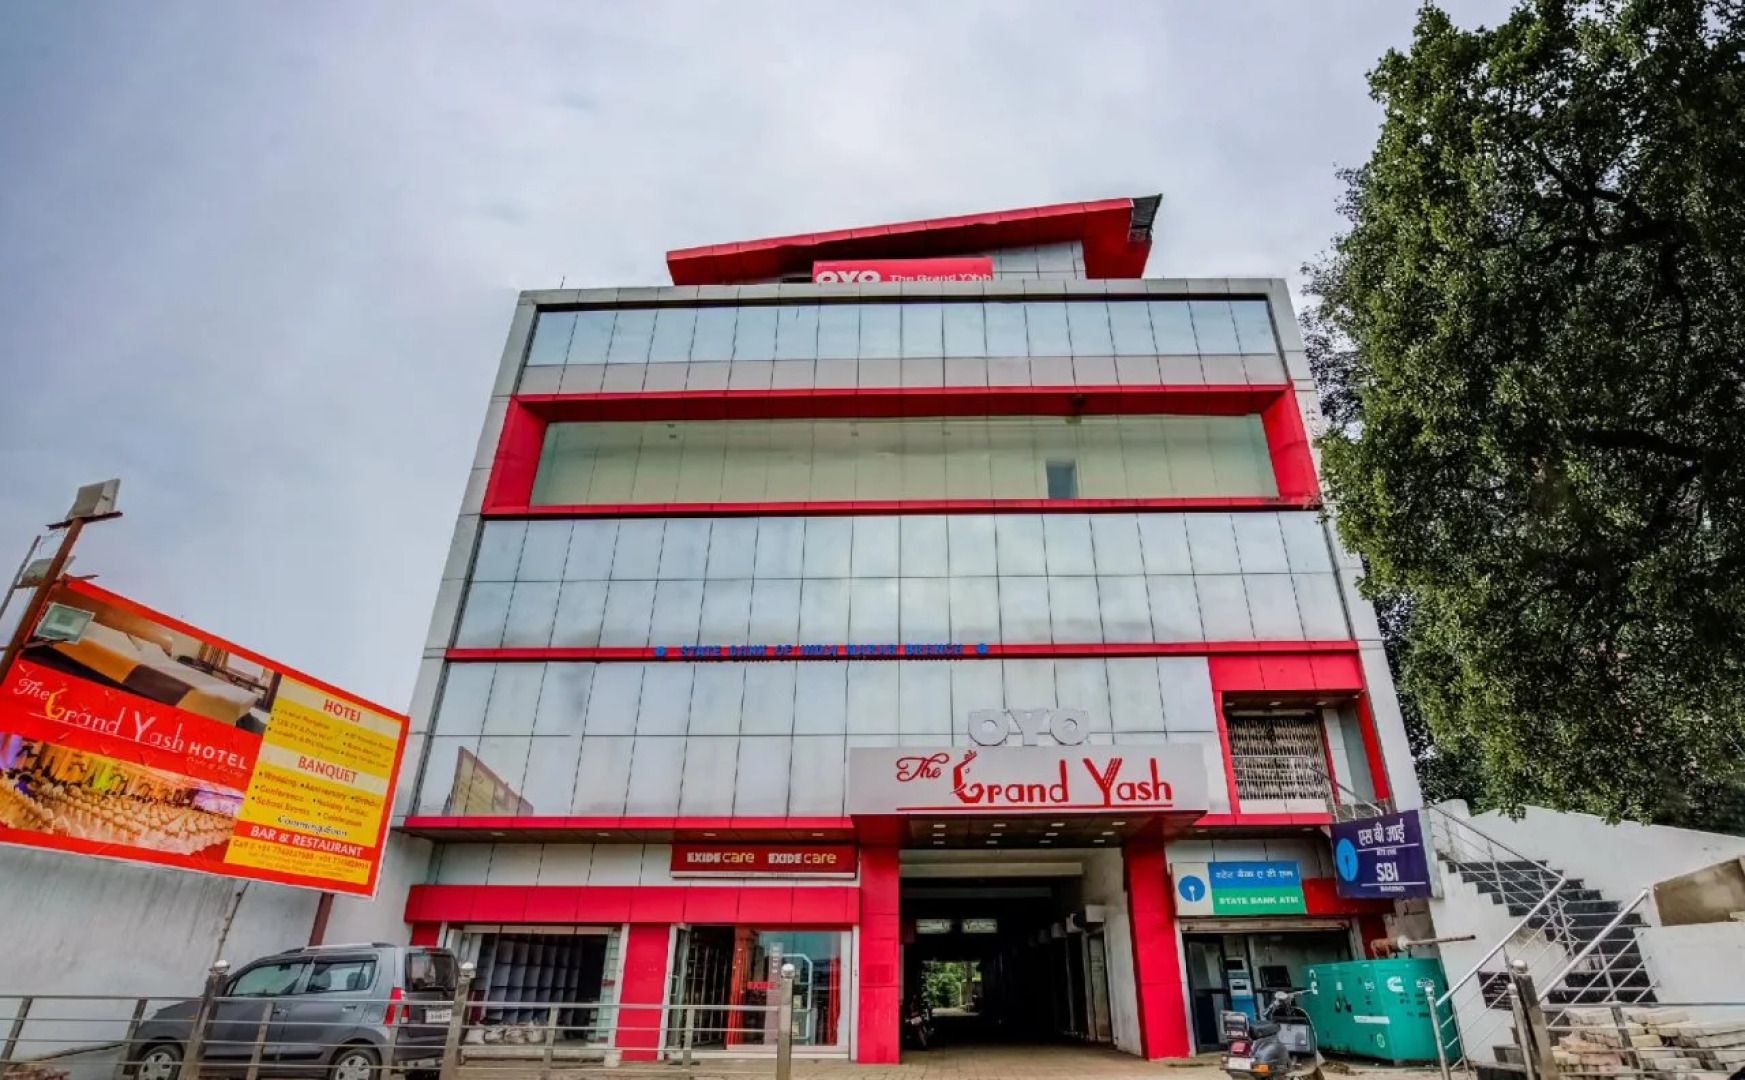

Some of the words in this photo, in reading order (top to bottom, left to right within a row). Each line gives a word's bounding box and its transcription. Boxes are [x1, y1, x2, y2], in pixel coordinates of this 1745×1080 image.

[13, 678, 50, 701] The
[45, 686, 126, 736] Grand
[133, 711, 185, 752] Yash
[188, 742, 247, 770] HOTEL
[968, 708, 1090, 747] OYO
[298, 756, 359, 784] BANQUET
[896, 753, 949, 782] The
[950, 750, 1069, 804] Grand
[1083, 757, 1172, 807] Yash
[250, 825, 276, 840] BAR
[279, 833, 290, 842] &
[292, 834, 363, 856] RESTAURANT
[1358, 828, 1373, 846] एस
[1373, 821, 1384, 843] बी
[1385, 818, 1404, 843] आई
[1376, 861, 1399, 881] SBI
[1219, 896, 1247, 905] STATE
[1250, 896, 1276, 905] BANK
[1279, 896, 1299, 904] ATM
